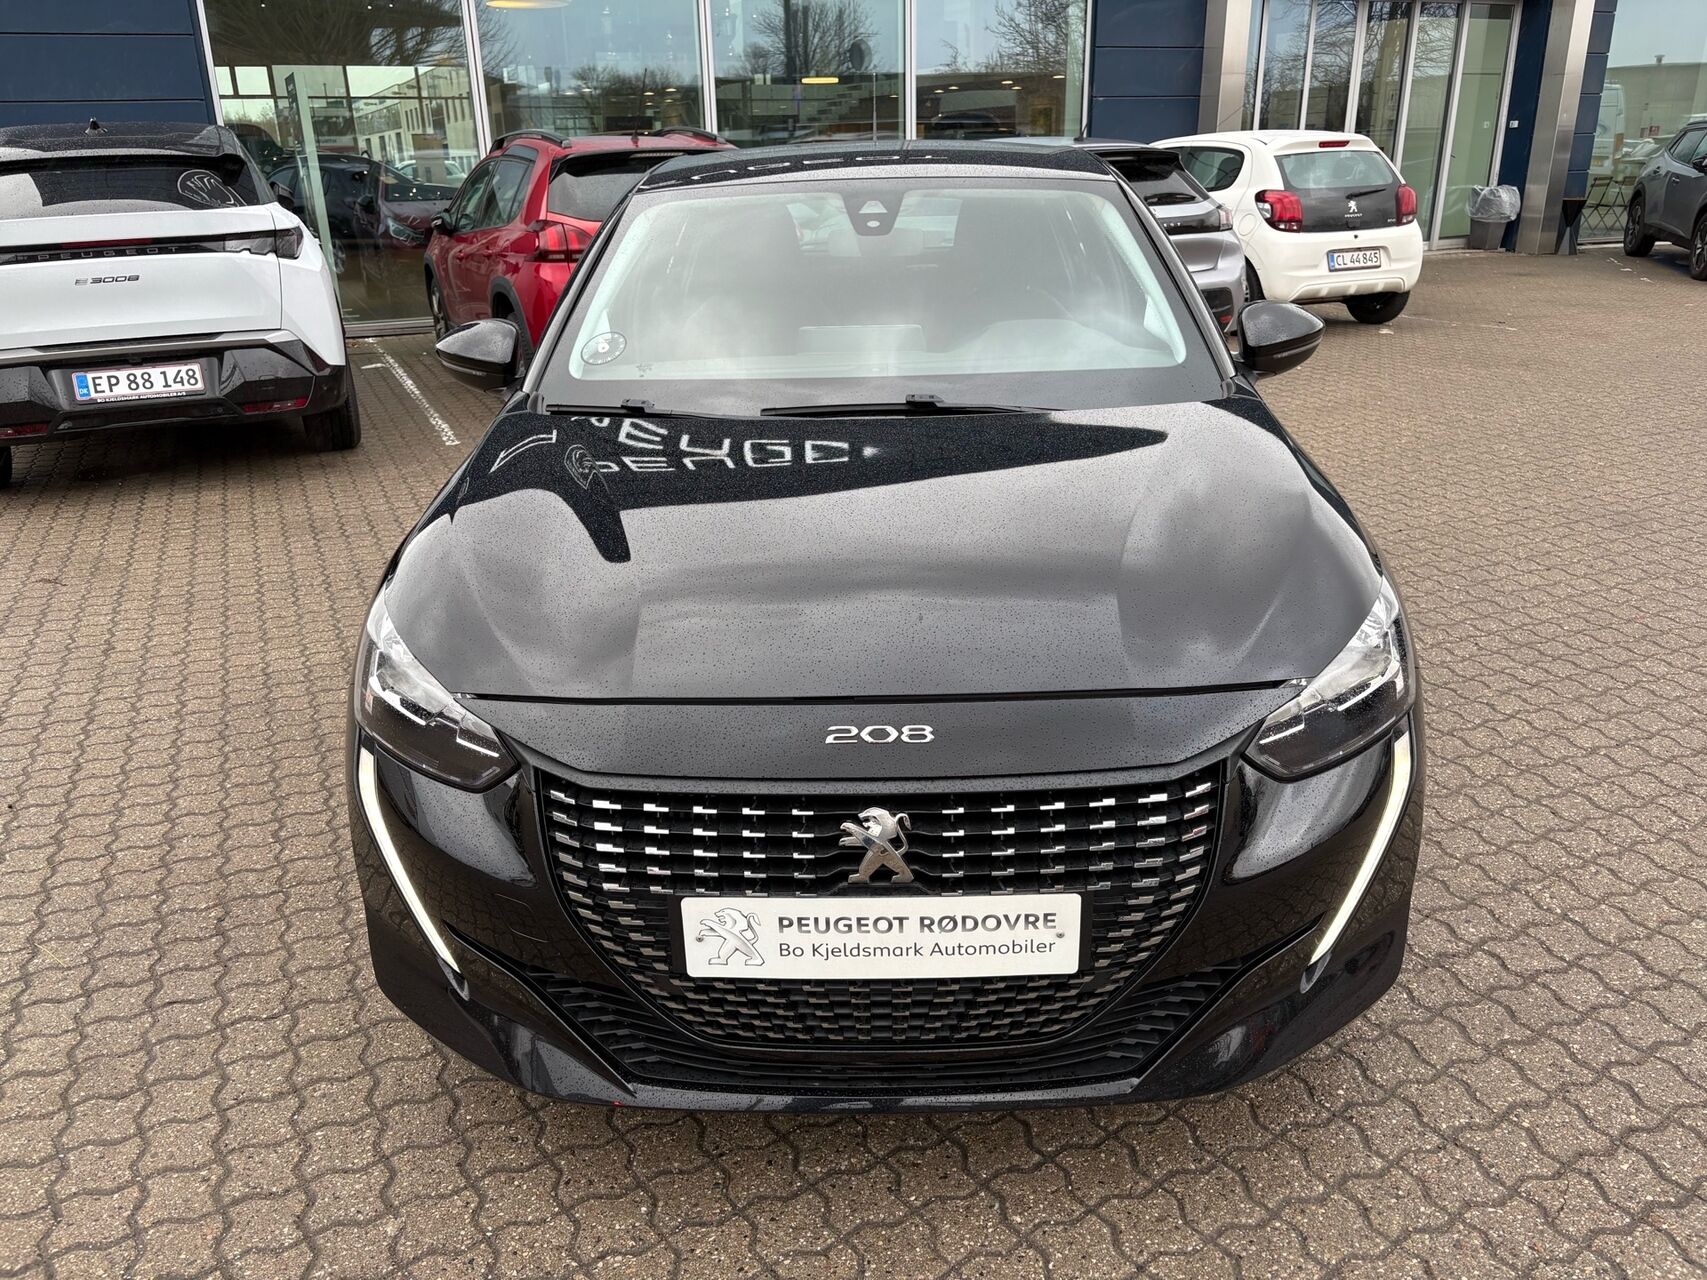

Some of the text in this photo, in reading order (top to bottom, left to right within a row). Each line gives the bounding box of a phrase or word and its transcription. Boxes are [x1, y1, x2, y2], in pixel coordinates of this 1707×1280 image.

[37, 246, 179, 262] PEUGEOT
[1335, 251, 1379, 266] CL 44 845
[91, 368, 199, 394] EP 88 148
[825, 724, 935, 744] 208
[778, 912, 1057, 934] PEUGEOT RØDOVRE
[779, 939, 1056, 960] Bo Kjeldsmark Automobiler
